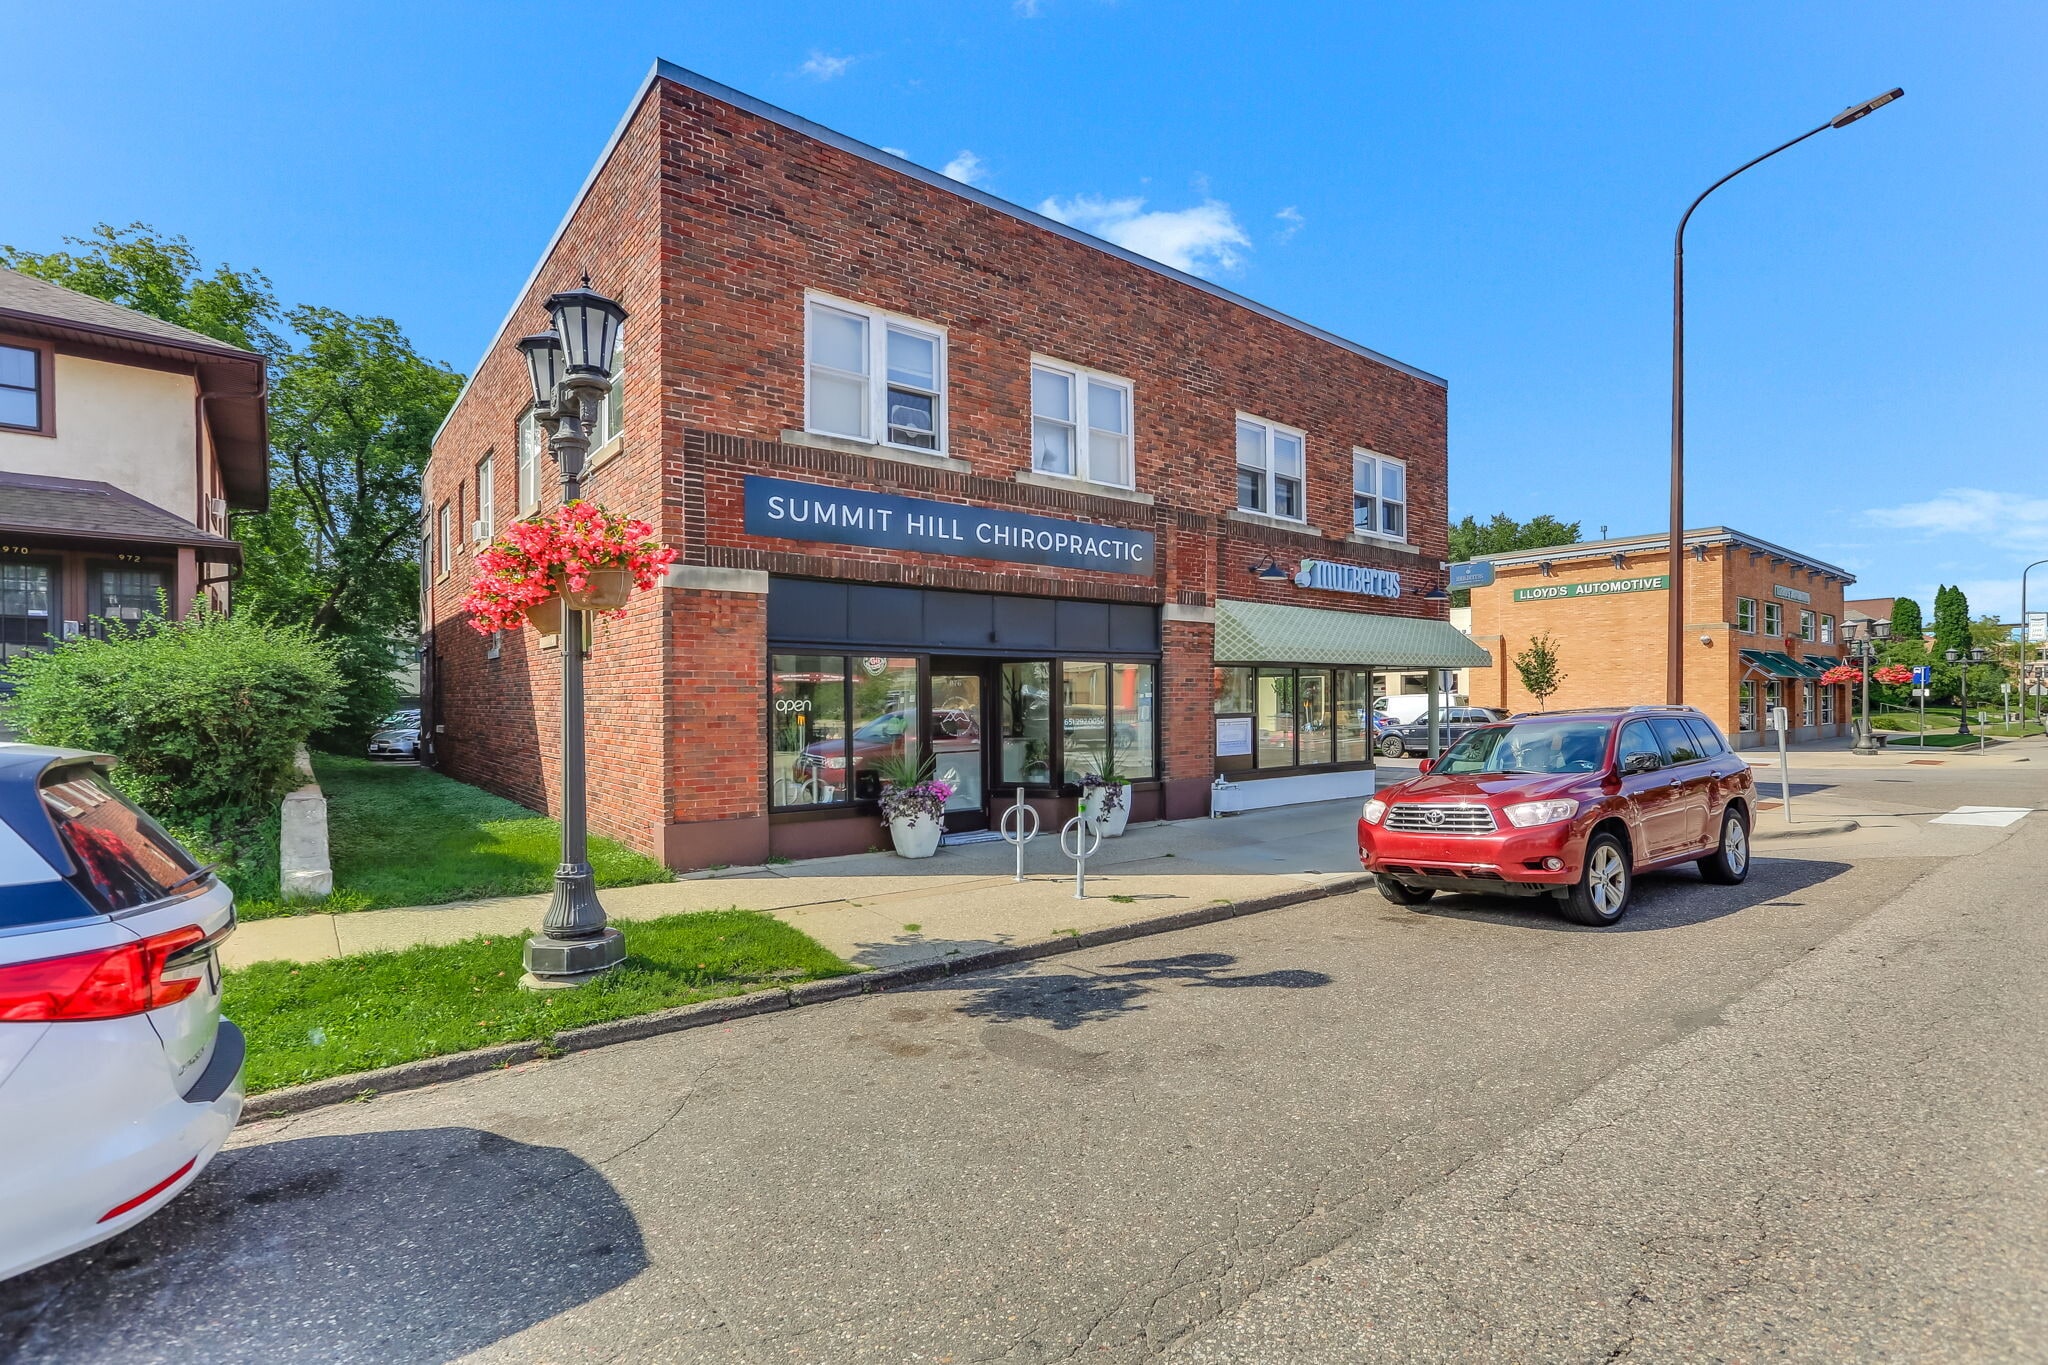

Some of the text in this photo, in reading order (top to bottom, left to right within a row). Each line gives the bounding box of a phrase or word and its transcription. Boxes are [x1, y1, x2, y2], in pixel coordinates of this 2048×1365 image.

[767, 496, 1144, 562] SUMMIT HILL CHIROPRACTIC
[2, 545, 28, 554] 970
[118, 554, 142, 563] 972
[1520, 577, 1662, 600] LLOYD'S AUTOMOTIVE
[775, 699, 812, 715] open
